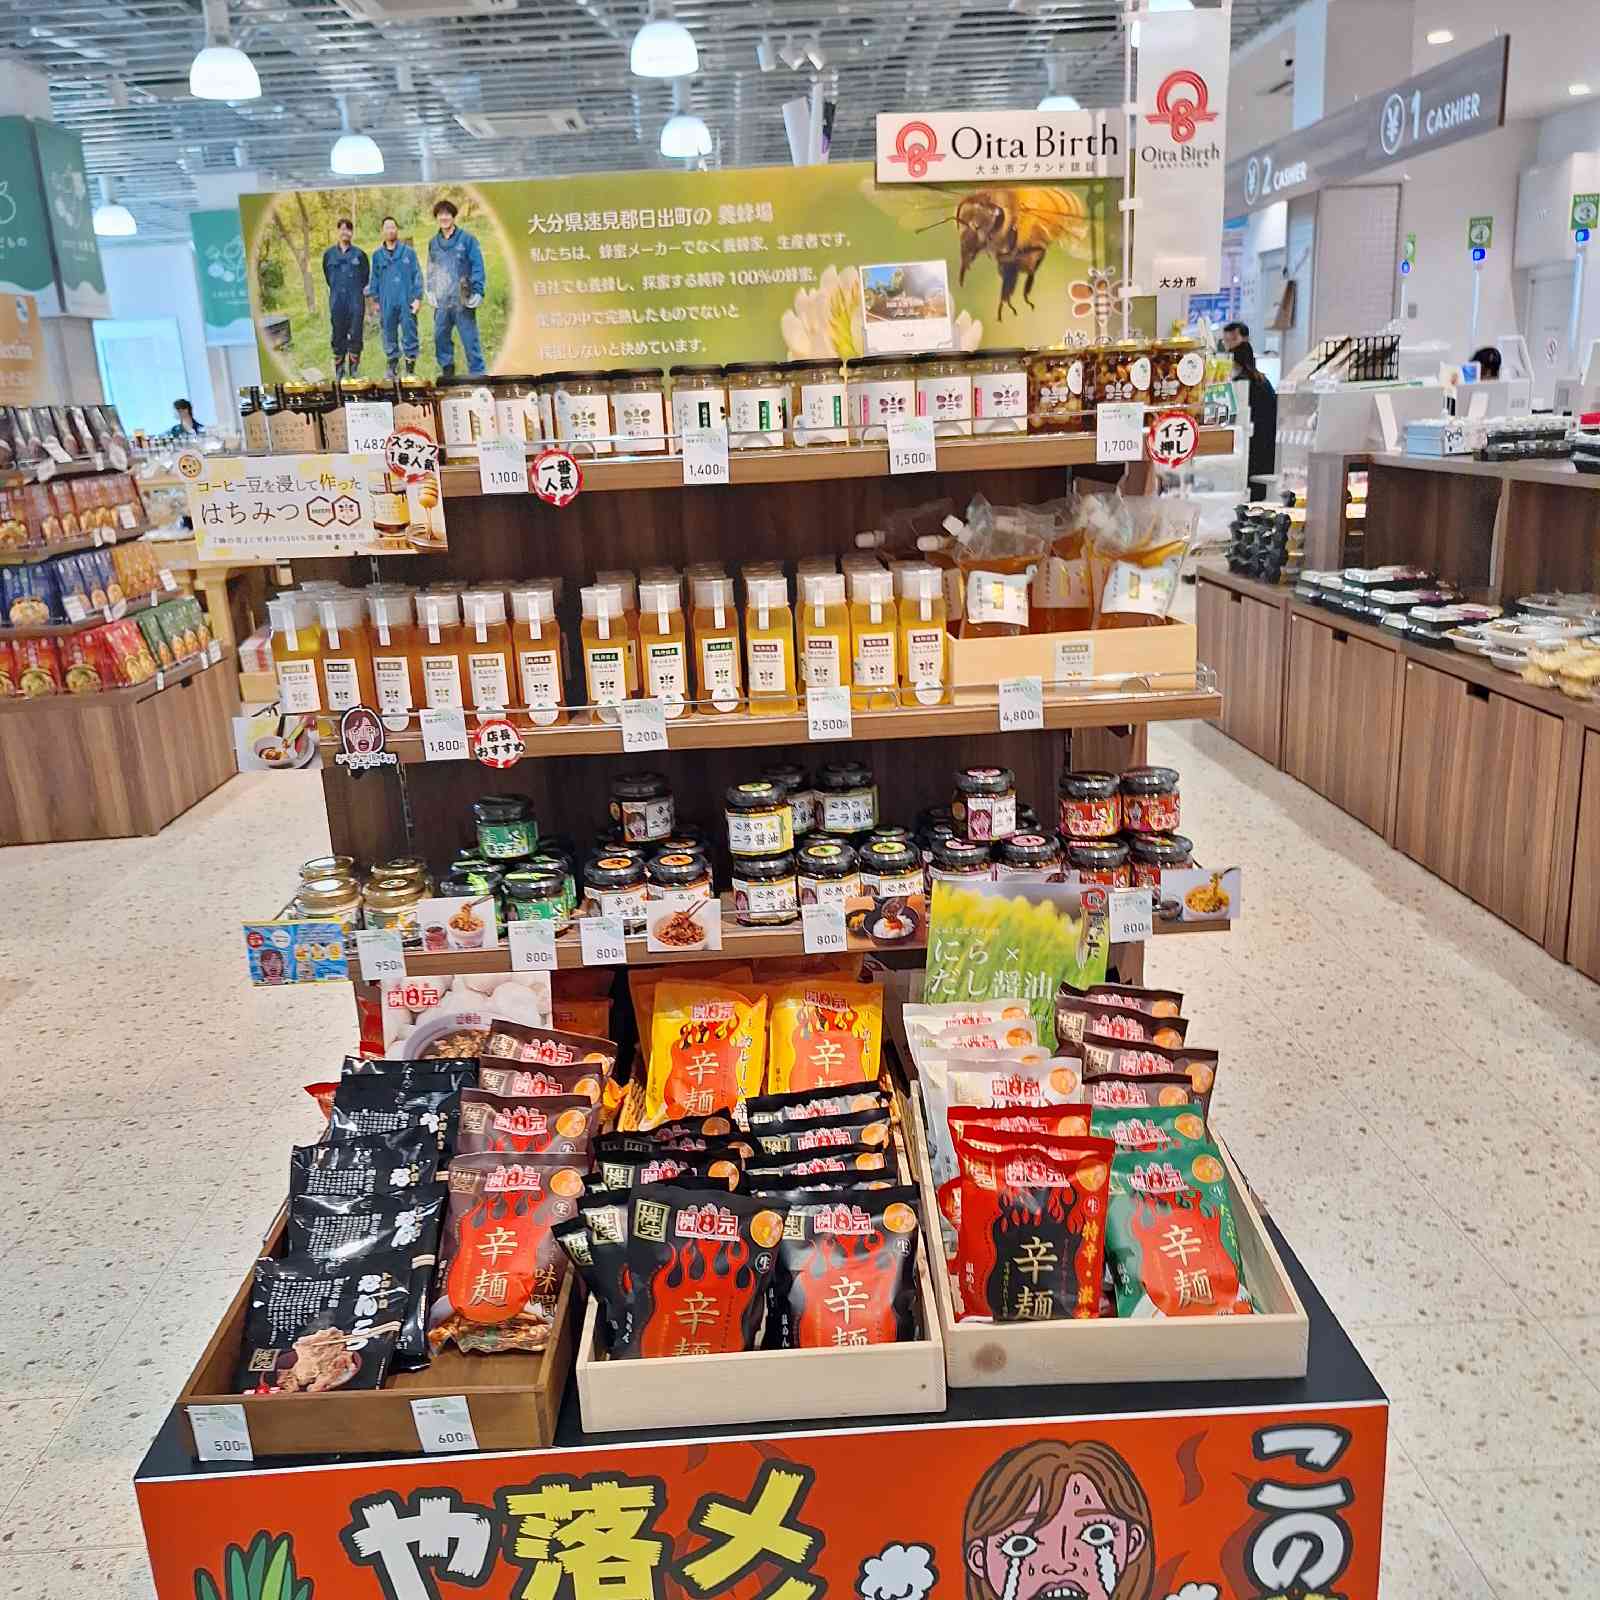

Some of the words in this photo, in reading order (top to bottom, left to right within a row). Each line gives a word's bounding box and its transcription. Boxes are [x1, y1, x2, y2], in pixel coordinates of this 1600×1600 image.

[1411, 89, 1422, 141] 1
[1425, 92, 1481, 135] CASHIER
[951, 125, 1025, 160] Oita
[1035, 122, 1119, 158] Birth
[1141, 145, 1178, 164] Oita
[1181, 143, 1221, 163] Birth
[1261, 156, 1272, 195] 2
[1273, 160, 1308, 192] CASHIER
[527, 206, 713, 235] 大分県速見郡日出町の
[1158, 275, 1198, 290] 大分市
[1160, 421, 1189, 438] イチ
[353, 438, 388, 451] 1,482
[391, 435, 440, 457] スタッフ
[1159, 440, 1188, 455] 押し
[389, 450, 436, 473] 1番人気
[541, 459, 572, 476] 一番
[197, 472, 363, 494] コーヒー豆を浸して作った
[544, 475, 574, 492] 人気
[200, 501, 300, 526] はちみつ
[486, 729, 511, 743] 店長
[477, 742, 525, 758] おすすめ
[929, 969, 1053, 1001] だし醤油
[807, 1039, 847, 1089] 辛
[469, 1226, 519, 1307] 辛麺
[1012, 1235, 1059, 1322] 辛麺
[1158, 1223, 1215, 1308] 辛麺
[1252, 1427, 1347, 1592] この
[504, 1480, 664, 1600] 落
[682, 1467, 822, 1600] メ
[350, 1495, 492, 1600] や
